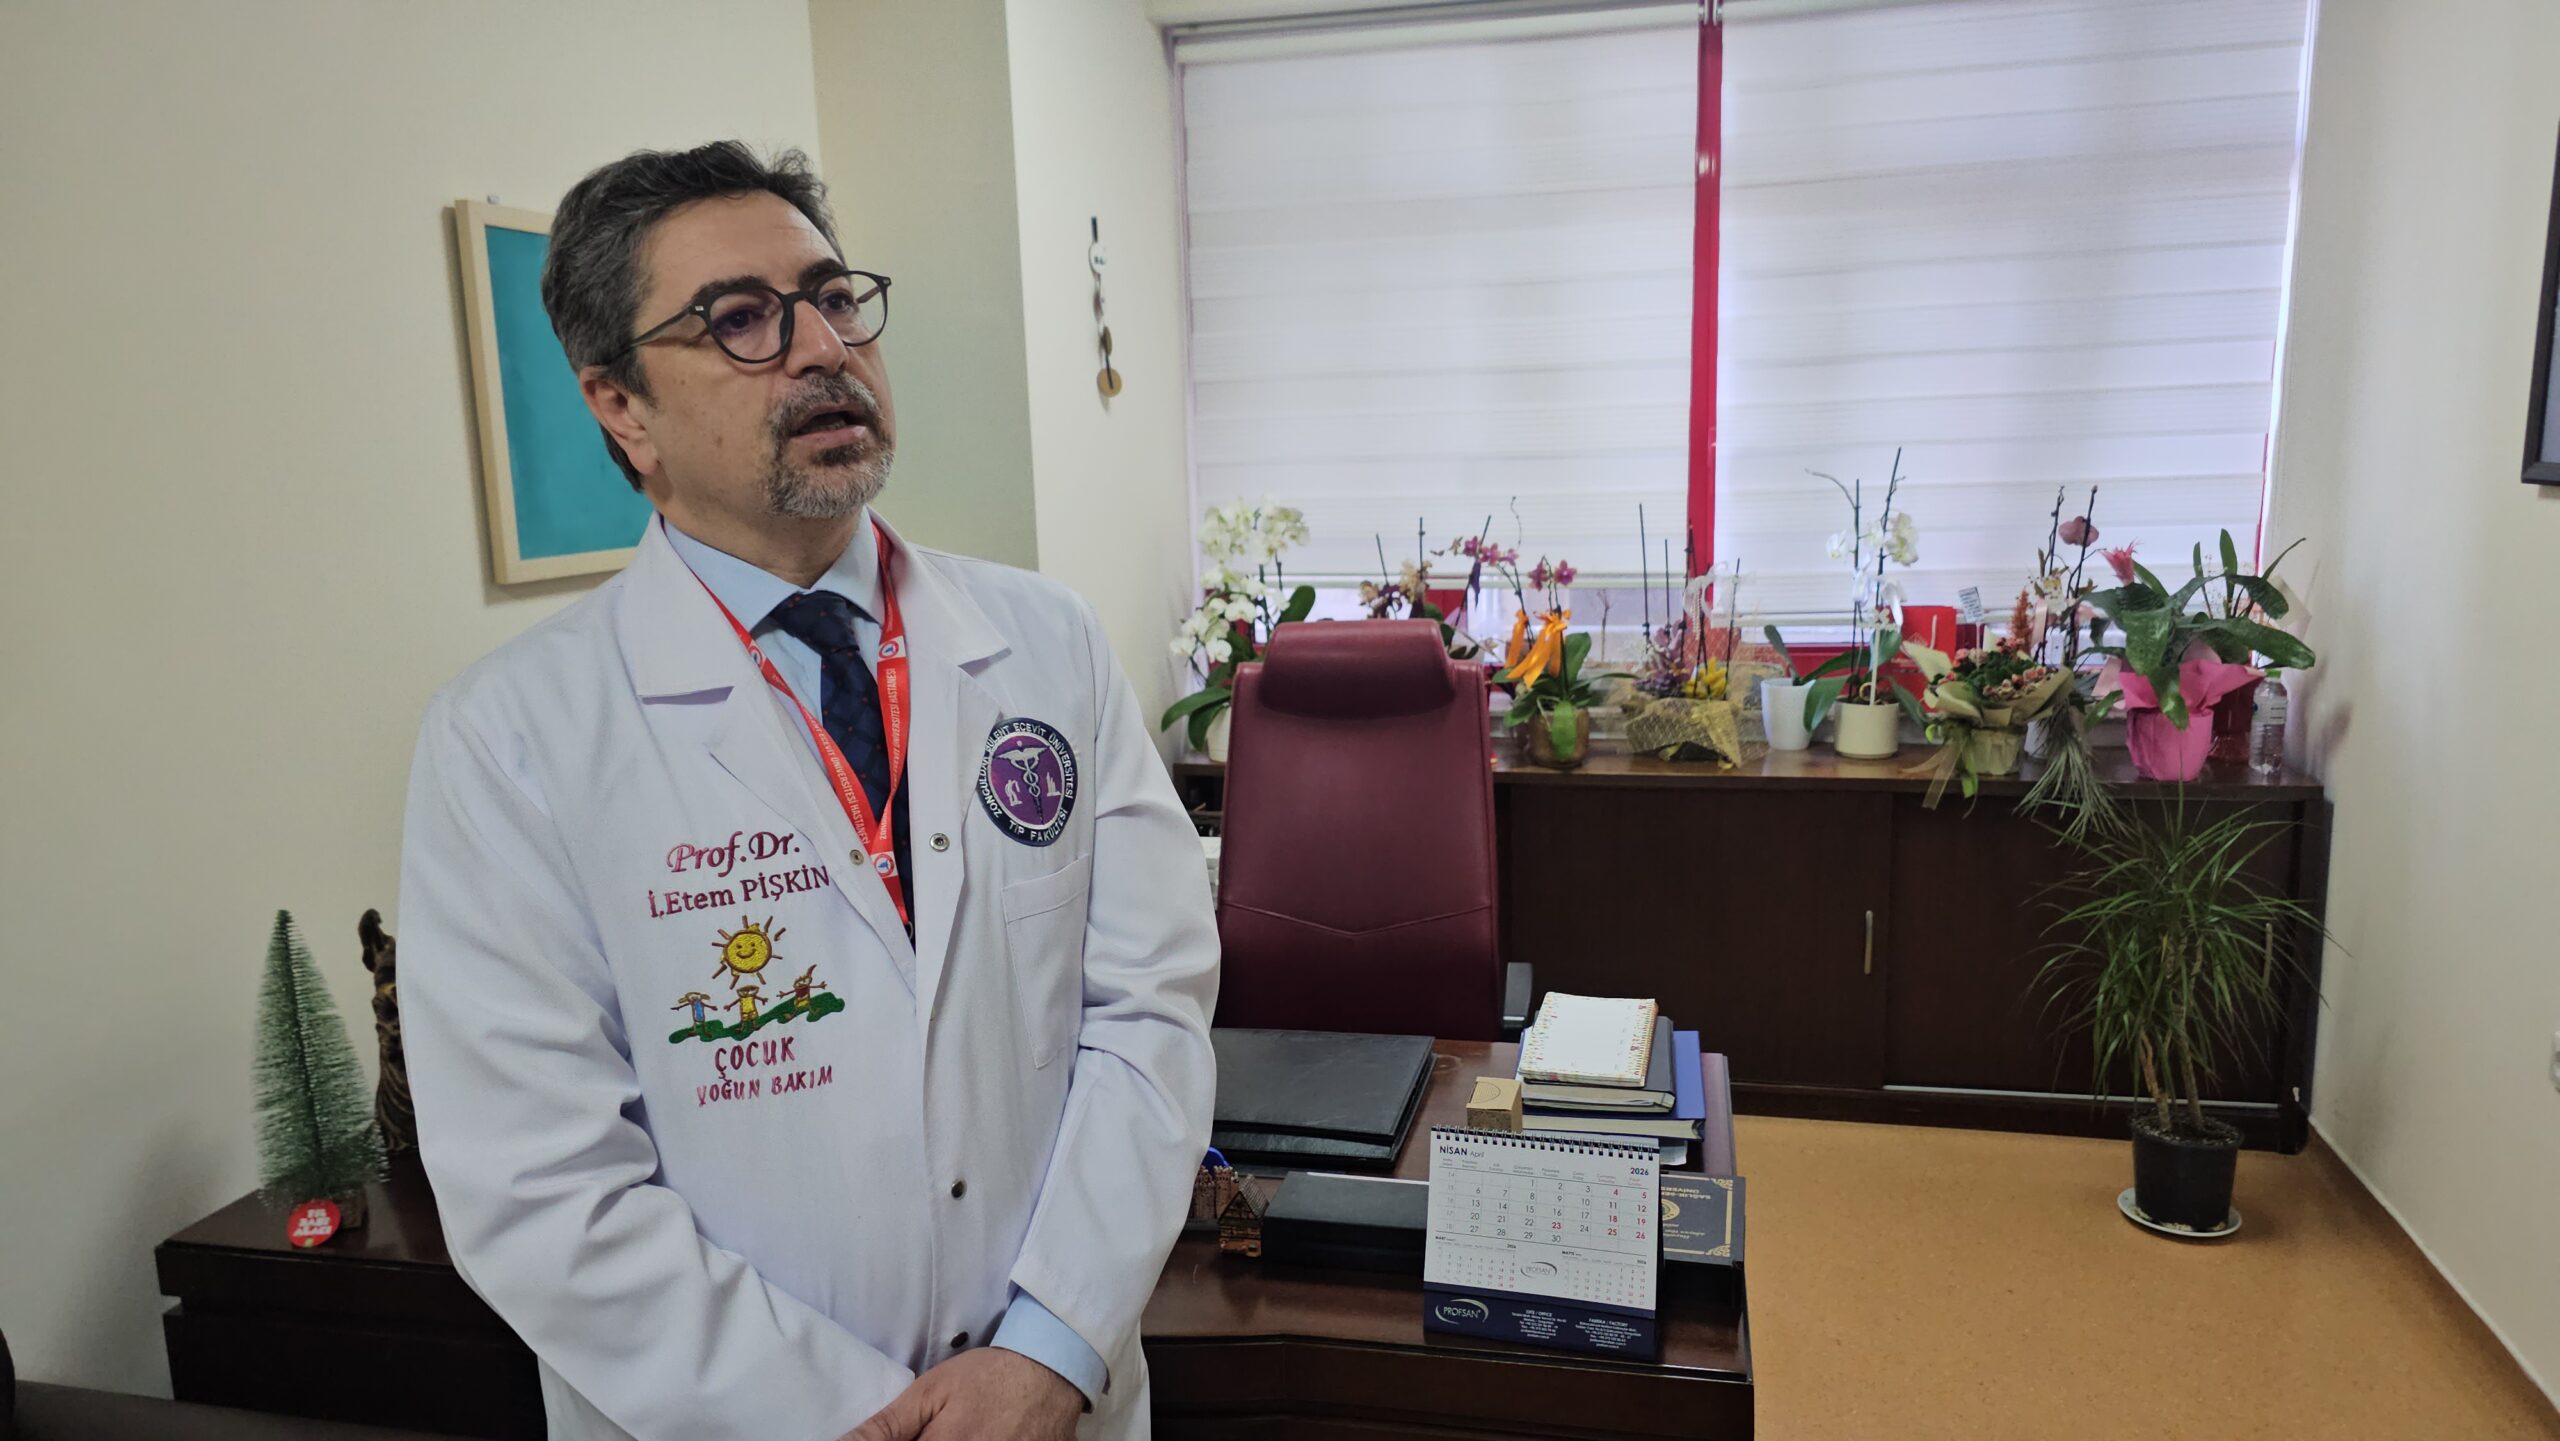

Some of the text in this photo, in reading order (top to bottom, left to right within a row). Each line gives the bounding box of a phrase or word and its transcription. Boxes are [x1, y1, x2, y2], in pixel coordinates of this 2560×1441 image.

[886, 668, 898, 704] HASTANESİ
[1013, 722, 1046, 737] ECEVİT
[740, 864, 830, 901] PİŞKİN
[714, 1036, 795, 1079] ÇOCUK
[697, 1065, 833, 1107] YOĞUN BAKIM
[1439, 1145, 1468, 1156] NİSAN
[1630, 1167, 1649, 1176] 2026
[1558, 1182, 1563, 1190] 2
[1585, 1185, 1591, 1193] 3
[1529, 1192, 1535, 1200] 8
[1557, 1194, 1563, 1202] 9
[1582, 1198, 1590, 1206] 10
[1609, 1201, 1617, 1209] 11
[1637, 1204, 1646, 1212] 12
[1499, 1202, 1507, 1210] 14
[1526, 1205, 1534, 1213] 15
[1553, 1208, 1562, 1216] 16
[1581, 1211, 1589, 1219] 17
[1609, 1215, 1618, 1223] 18
[1470, 1225, 1479, 1233] 27
[1497, 1228, 1506, 1236] 28
[1524, 1232, 1533, 1240] 29
[1552, 1235, 1562, 1243] 30
[1497, 1215, 1506, 1223] 21
[1525, 1218, 1534, 1226] 22
[1608, 1228, 1617, 1236] 25
[1636, 1232, 1645, 1240] 26
